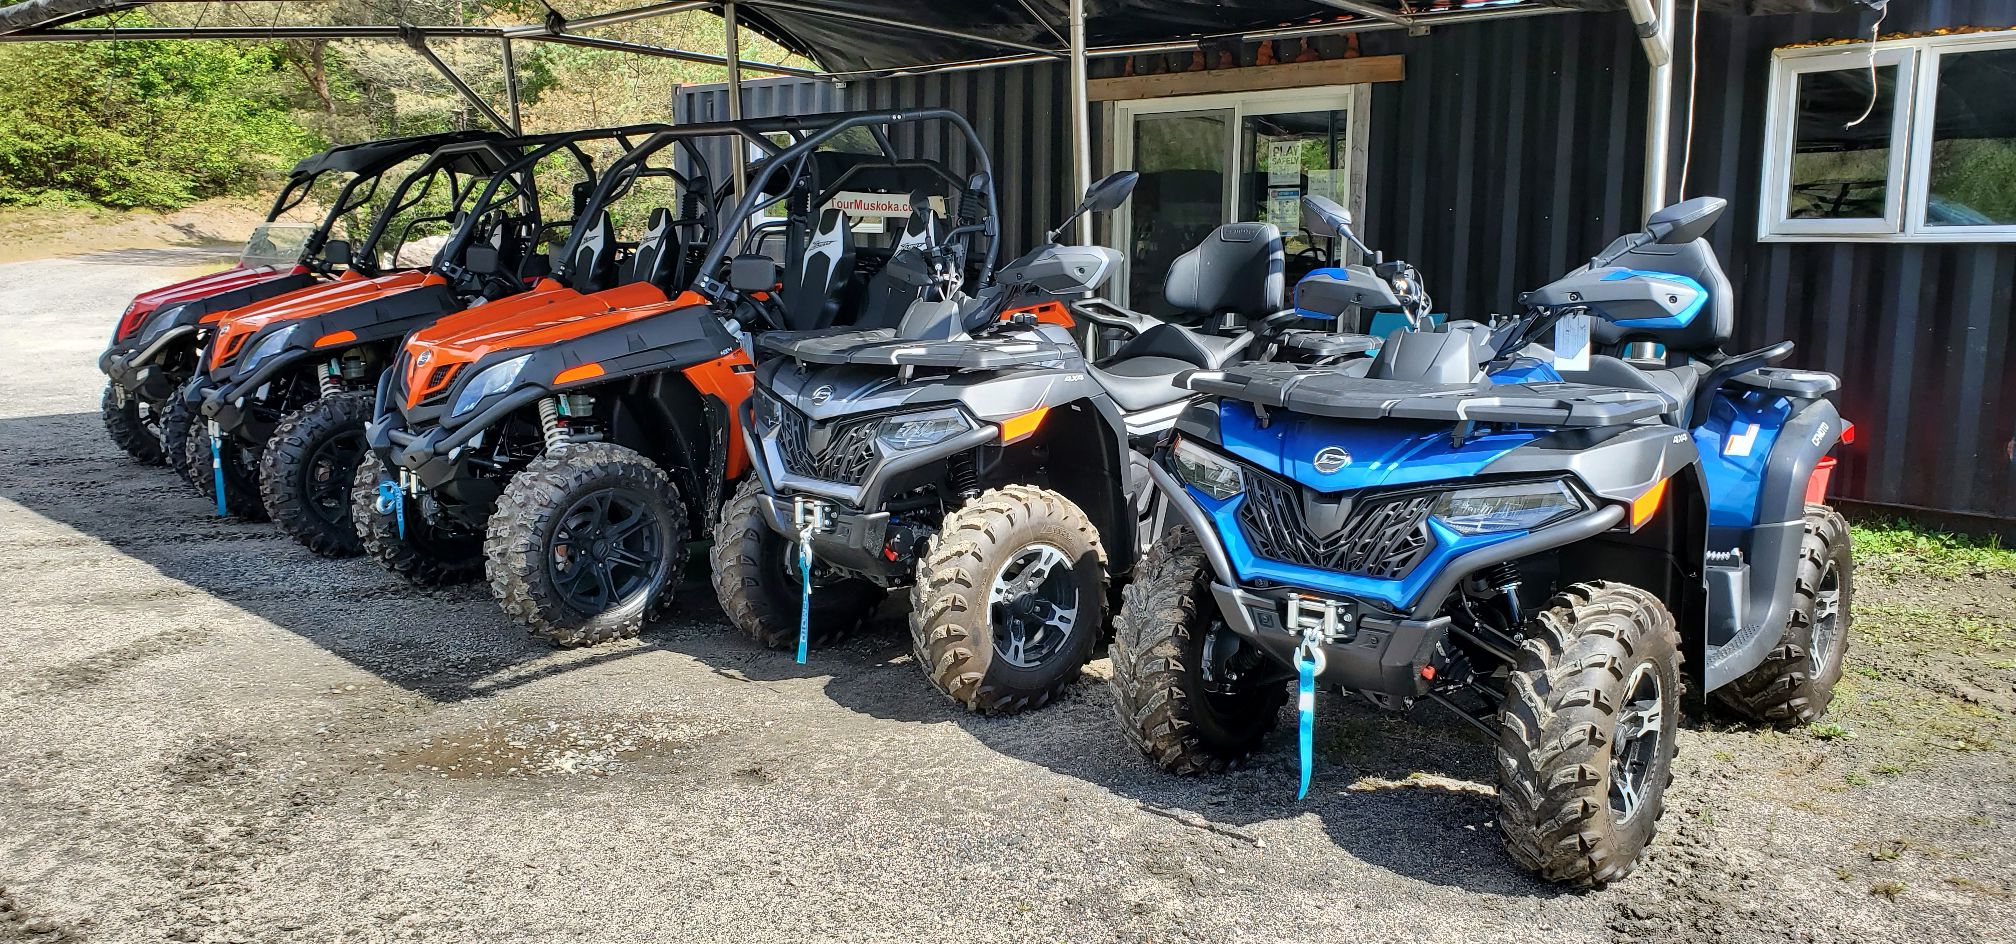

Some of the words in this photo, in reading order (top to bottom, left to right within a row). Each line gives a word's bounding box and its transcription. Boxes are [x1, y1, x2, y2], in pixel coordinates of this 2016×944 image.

[1273, 145, 1299, 157] PLAY
[1272, 157, 1299, 165] SAFELY
[831, 198, 914, 212] TourMuskoka.co
